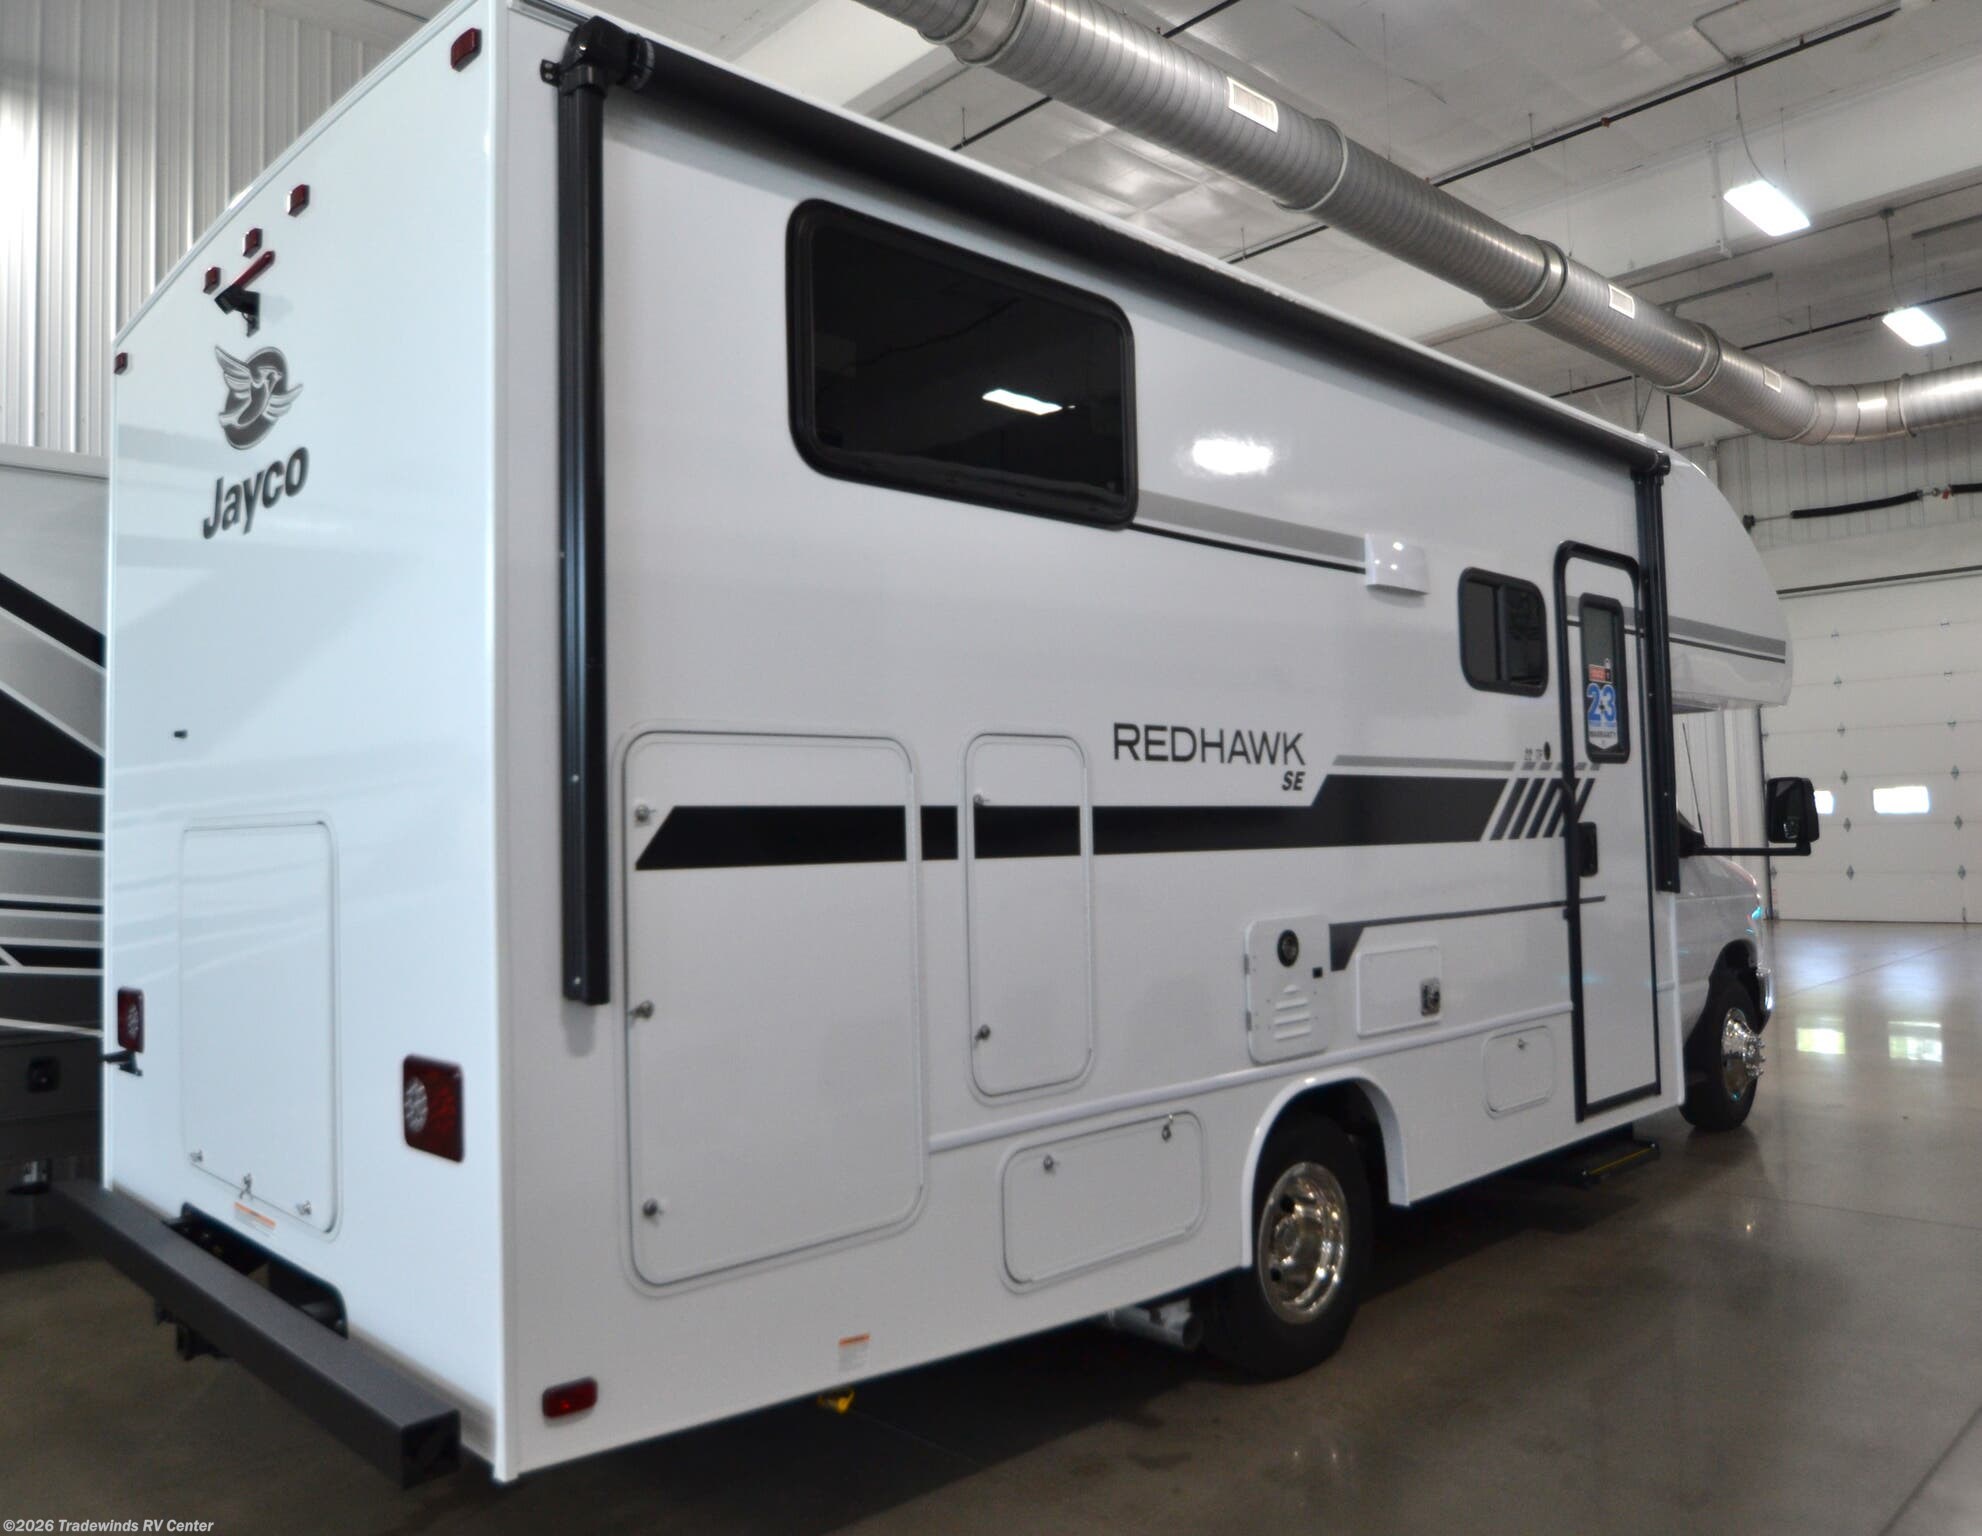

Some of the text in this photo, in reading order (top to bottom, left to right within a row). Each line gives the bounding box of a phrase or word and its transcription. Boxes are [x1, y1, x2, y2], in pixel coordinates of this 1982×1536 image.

[202, 447, 310, 540] Jayco
[1113, 722, 1306, 766] REDHAWK
[1281, 770, 1306, 791] SE
